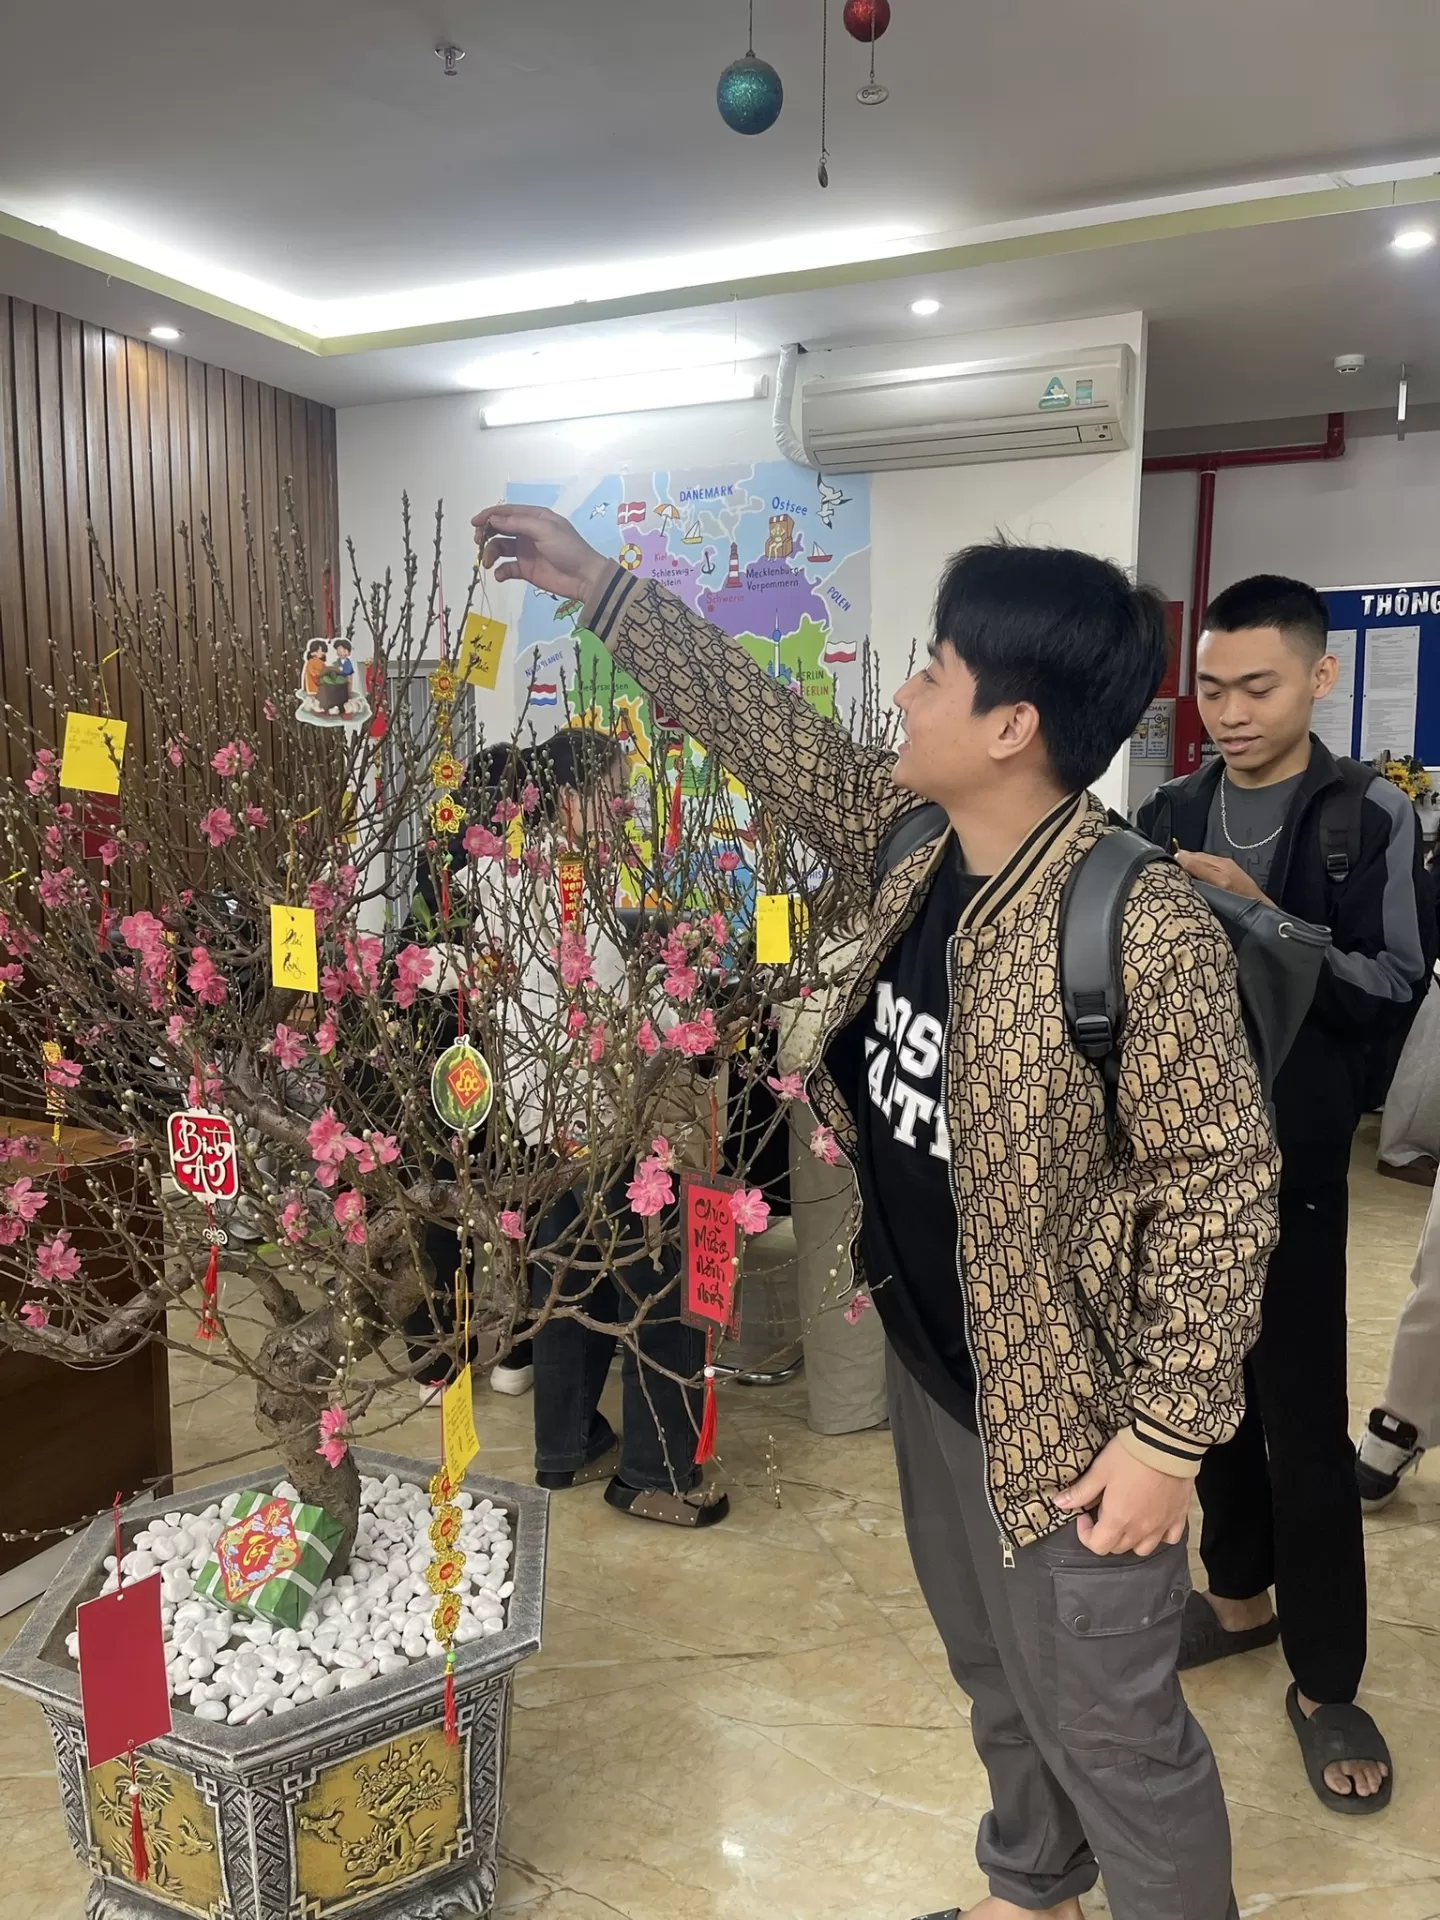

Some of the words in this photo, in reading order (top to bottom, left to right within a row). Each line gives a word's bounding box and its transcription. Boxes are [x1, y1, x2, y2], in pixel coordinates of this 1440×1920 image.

[680, 484, 734, 502] DÄNEMARK
[771, 496, 808, 516] Ostsee
[651, 567, 694, 579] Schleswig-
[746, 579, 799, 592] Vorpommern
[706, 594, 744, 604] Schwerin
[826, 586, 851, 612] POLEN
[1361, 588, 1440, 617] THÔNG
